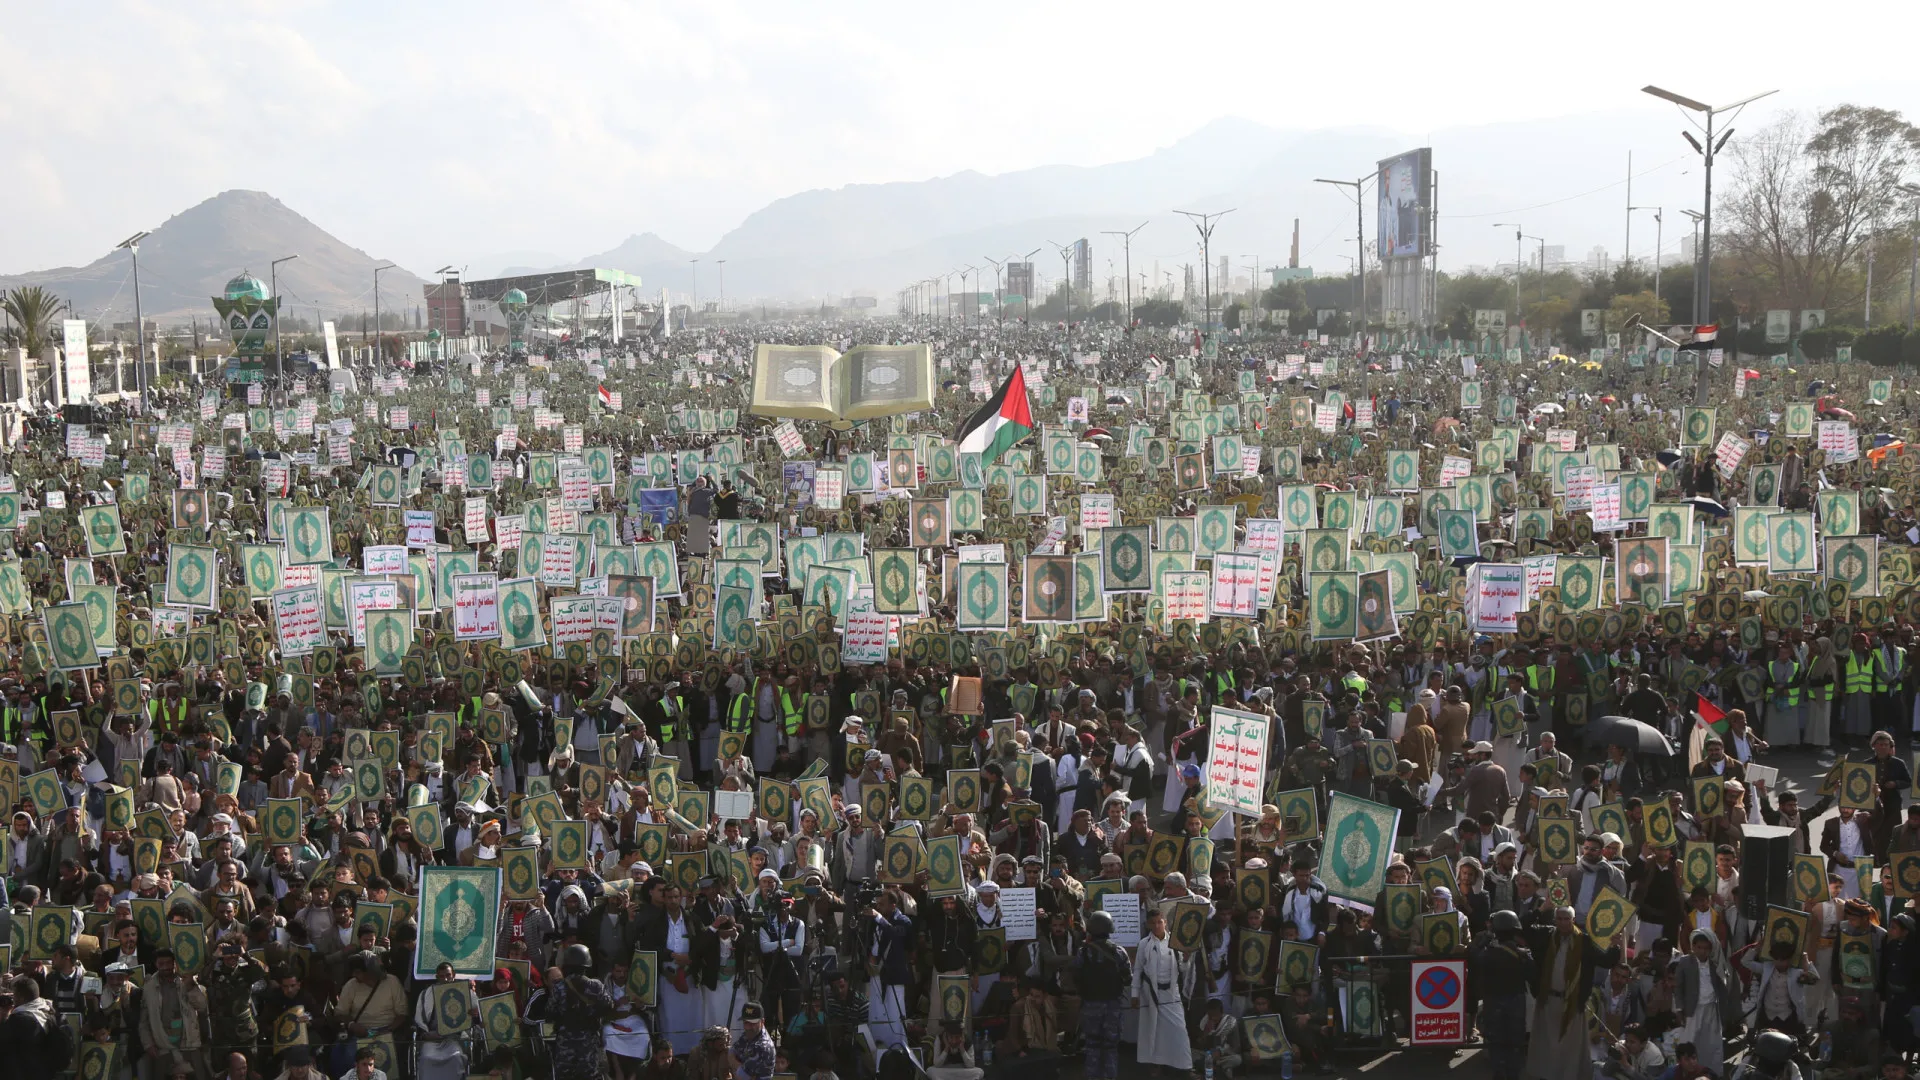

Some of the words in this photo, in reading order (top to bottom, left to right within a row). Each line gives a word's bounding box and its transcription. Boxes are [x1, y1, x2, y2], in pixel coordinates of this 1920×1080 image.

[370, 552, 386, 563] أكبر
[389, 552, 400, 560] الله
[1219, 560, 1256, 571] قاطعوا
[1169, 575, 1190, 587] أكبر
[1482, 570, 1519, 584] قاطعوا
[458, 577, 493, 593] قاطعوا
[302, 594, 316, 603] الله
[357, 587, 378, 600] أكبر
[379, 588, 393, 597] الله
[278, 594, 299, 609] أكبر
[579, 602, 592, 612] الله
[556, 602, 578, 617] أكبر
[609, 603, 620, 613] الله
[849, 602, 872, 615] أكبر
[1217, 722, 1245, 738] أكبر
[1245, 722, 1263, 739] الله
[1216, 739, 1239, 752] لأمريكا
[1240, 745, 1261, 757] الموت
[1213, 755, 1238, 768] لإسرائيل
[1239, 762, 1259, 772] الموت
[1211, 771, 1229, 782] اليهود
[1230, 775, 1240, 786] على
[1242, 778, 1258, 789] اللعنة
[1212, 785, 1234, 800] للإسلام
[1237, 791, 1257, 805] النصر
